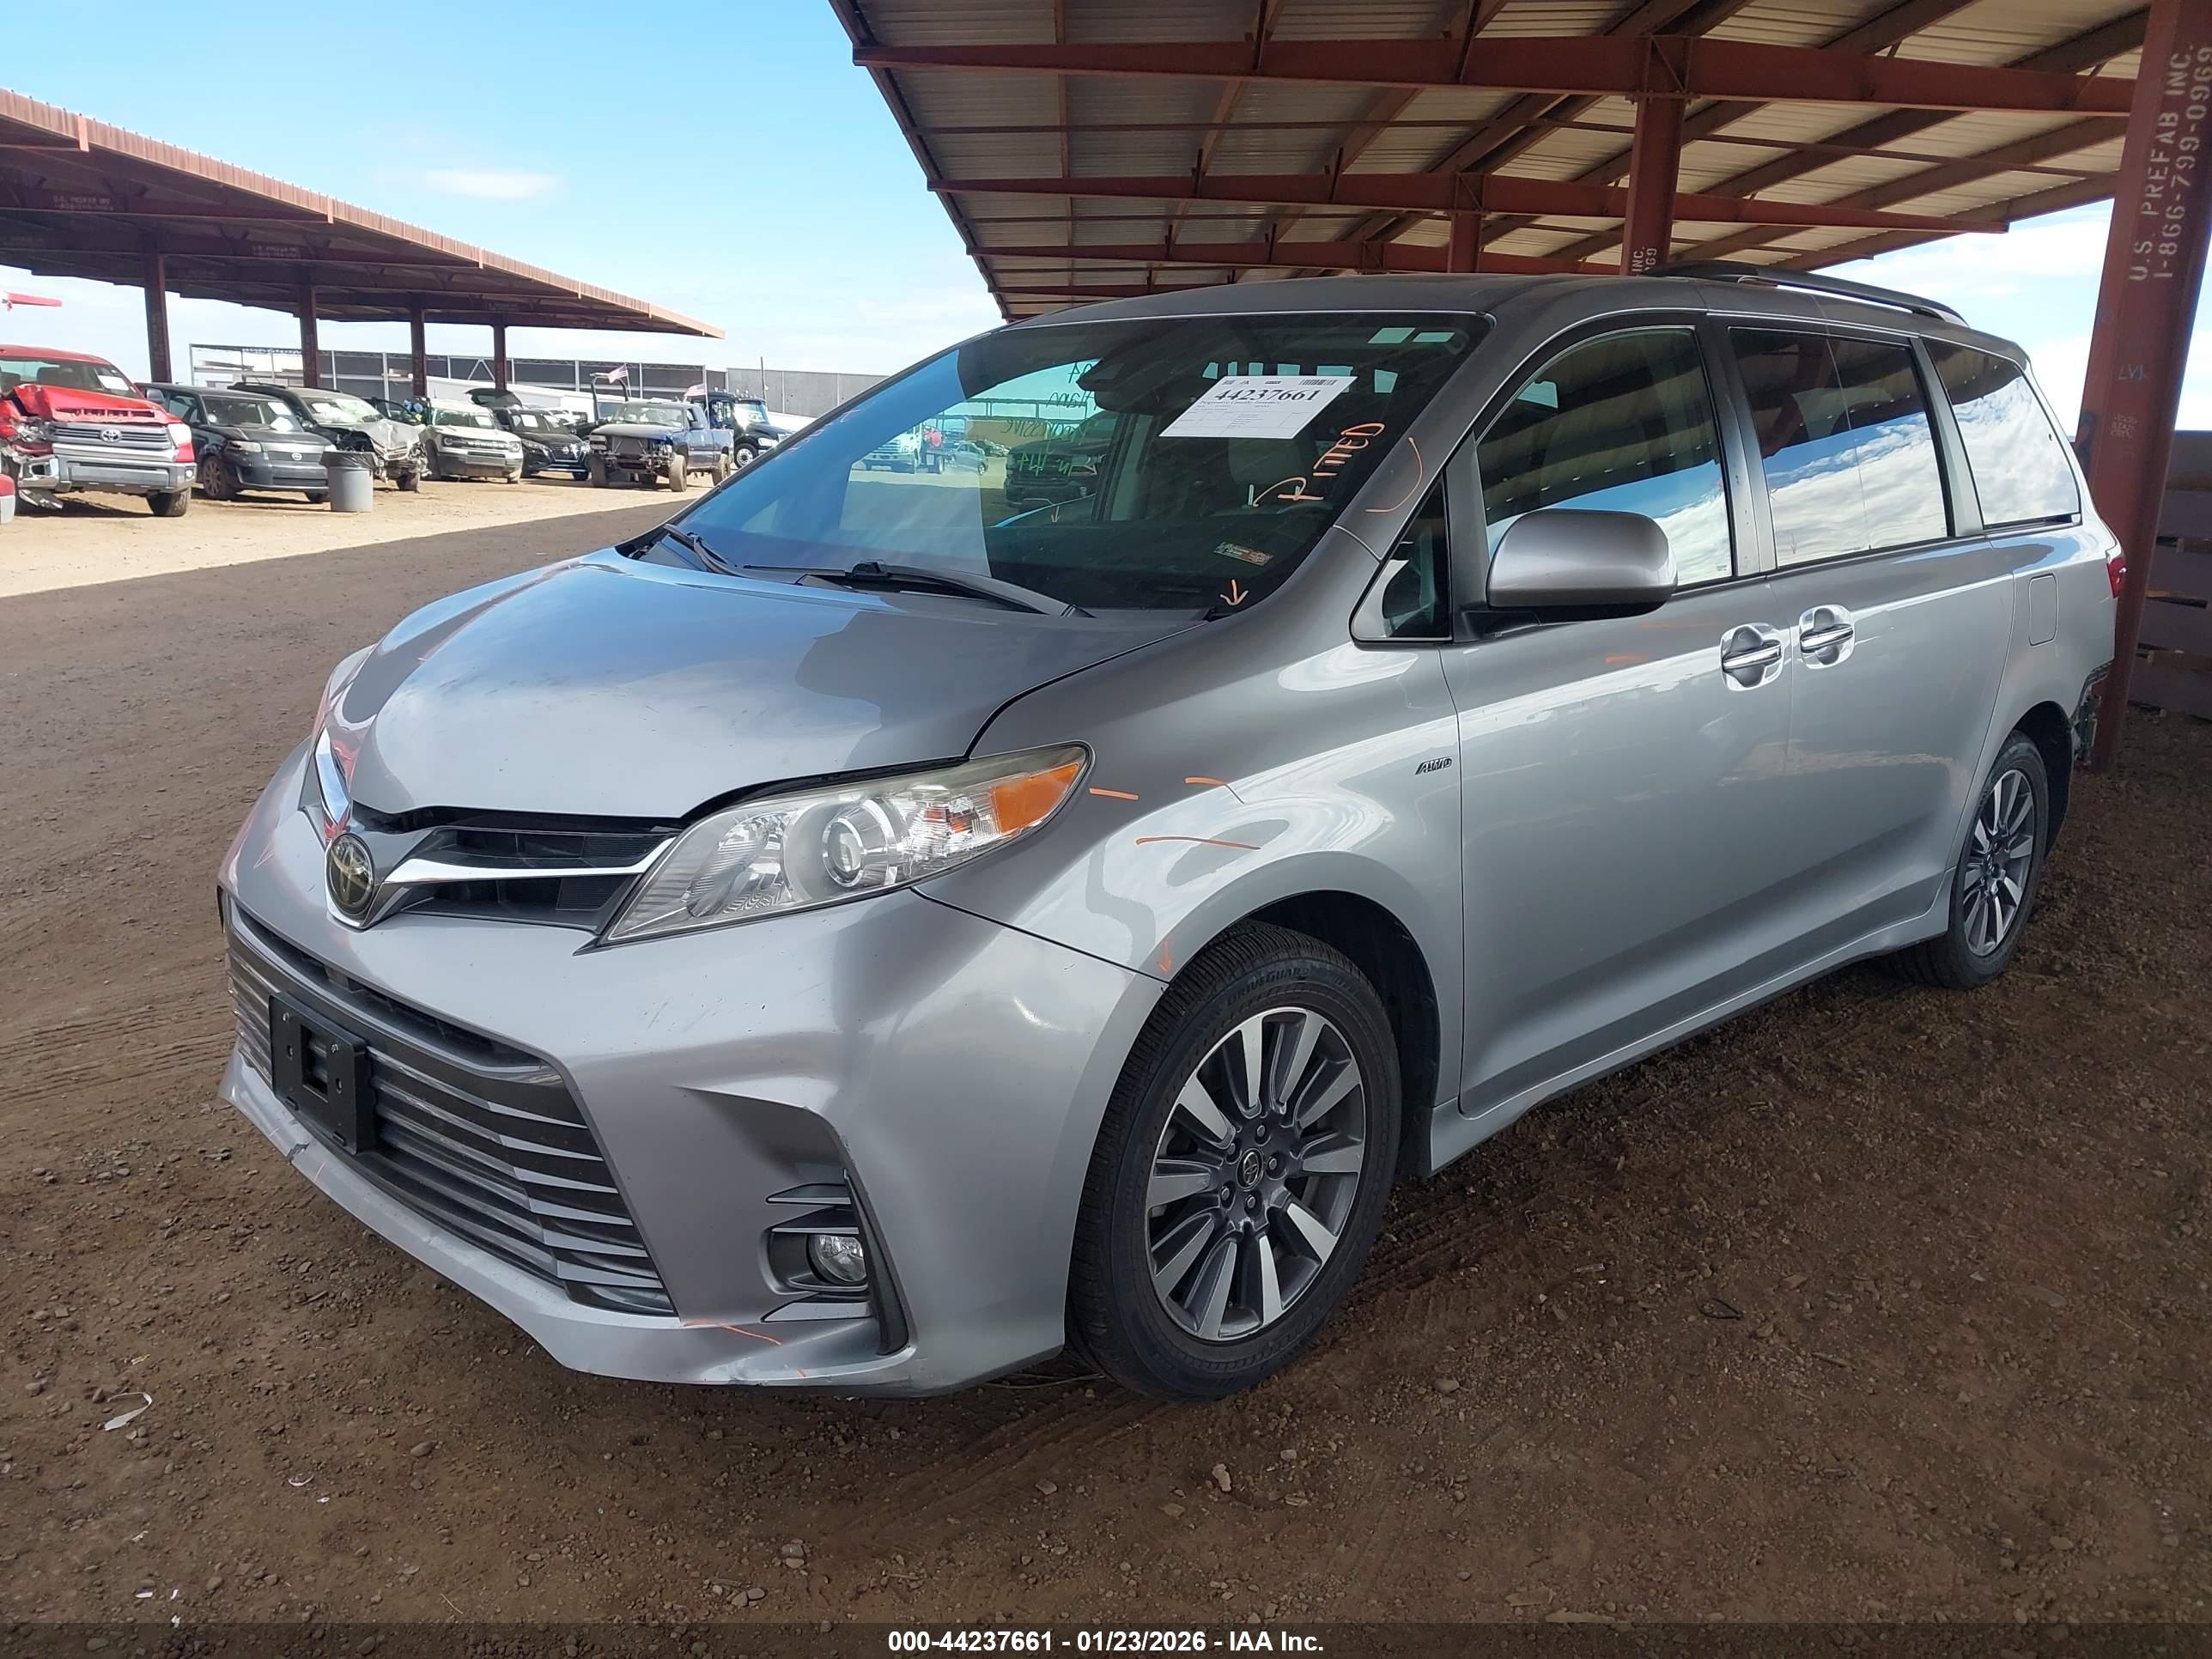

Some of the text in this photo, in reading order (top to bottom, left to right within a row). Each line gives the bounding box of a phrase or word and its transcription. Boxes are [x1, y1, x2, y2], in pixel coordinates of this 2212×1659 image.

[2129, 45, 2194, 281] U.S. PREFAB INC.
[2154, 46, 2212, 277] 1-866-799-0969
[1632, 246, 1644, 272] INC.
[1214, 389, 1321, 401] 44237661
[1415, 757, 1452, 775] AWD
